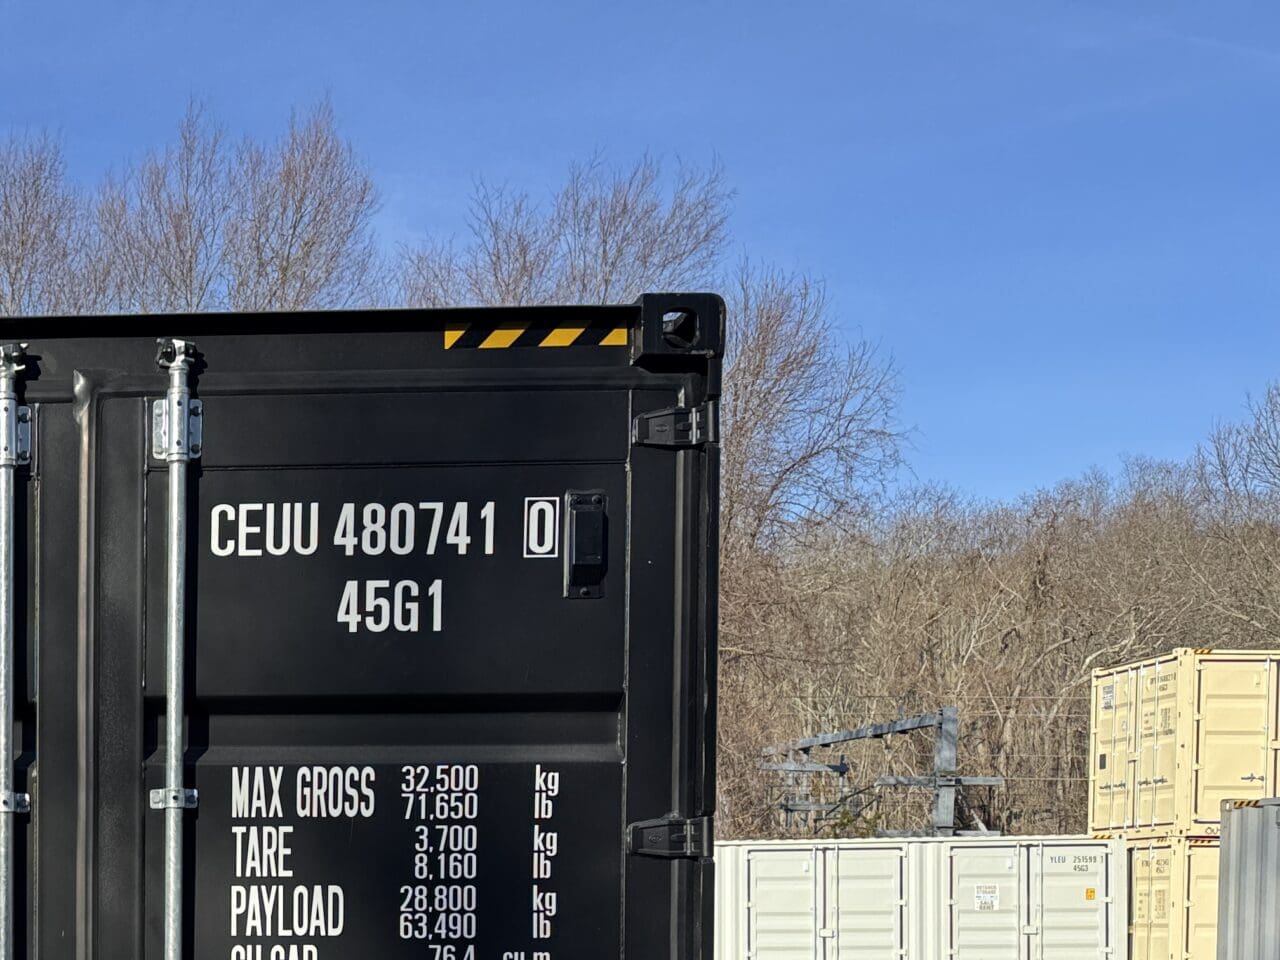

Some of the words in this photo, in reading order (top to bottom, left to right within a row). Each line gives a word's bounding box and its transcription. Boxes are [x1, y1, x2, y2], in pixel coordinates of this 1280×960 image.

[210, 502, 320, 557] CEUU
[333, 501, 496, 556] 480741
[528, 501, 552, 554] 0
[336, 579, 443, 633] 45G1
[231, 766, 284, 818] MAX
[296, 766, 376, 818] GROSS
[401, 765, 479, 793] 32,500
[535, 764, 559, 796] kg
[401, 793, 479, 821] 71,650
[534, 793, 553, 819] lb
[232, 826, 293, 877] TARE
[415, 825, 477, 853] 3,700
[533, 824, 558, 857] kg
[415, 853, 477, 881] 8,160
[532, 853, 551, 879] lb
[230, 885, 344, 937] PAYLOAD
[399, 885, 477, 914] 28,800
[532, 884, 557, 916] kg
[399, 913, 477, 941] 63,490
[532, 913, 551, 939] lb
